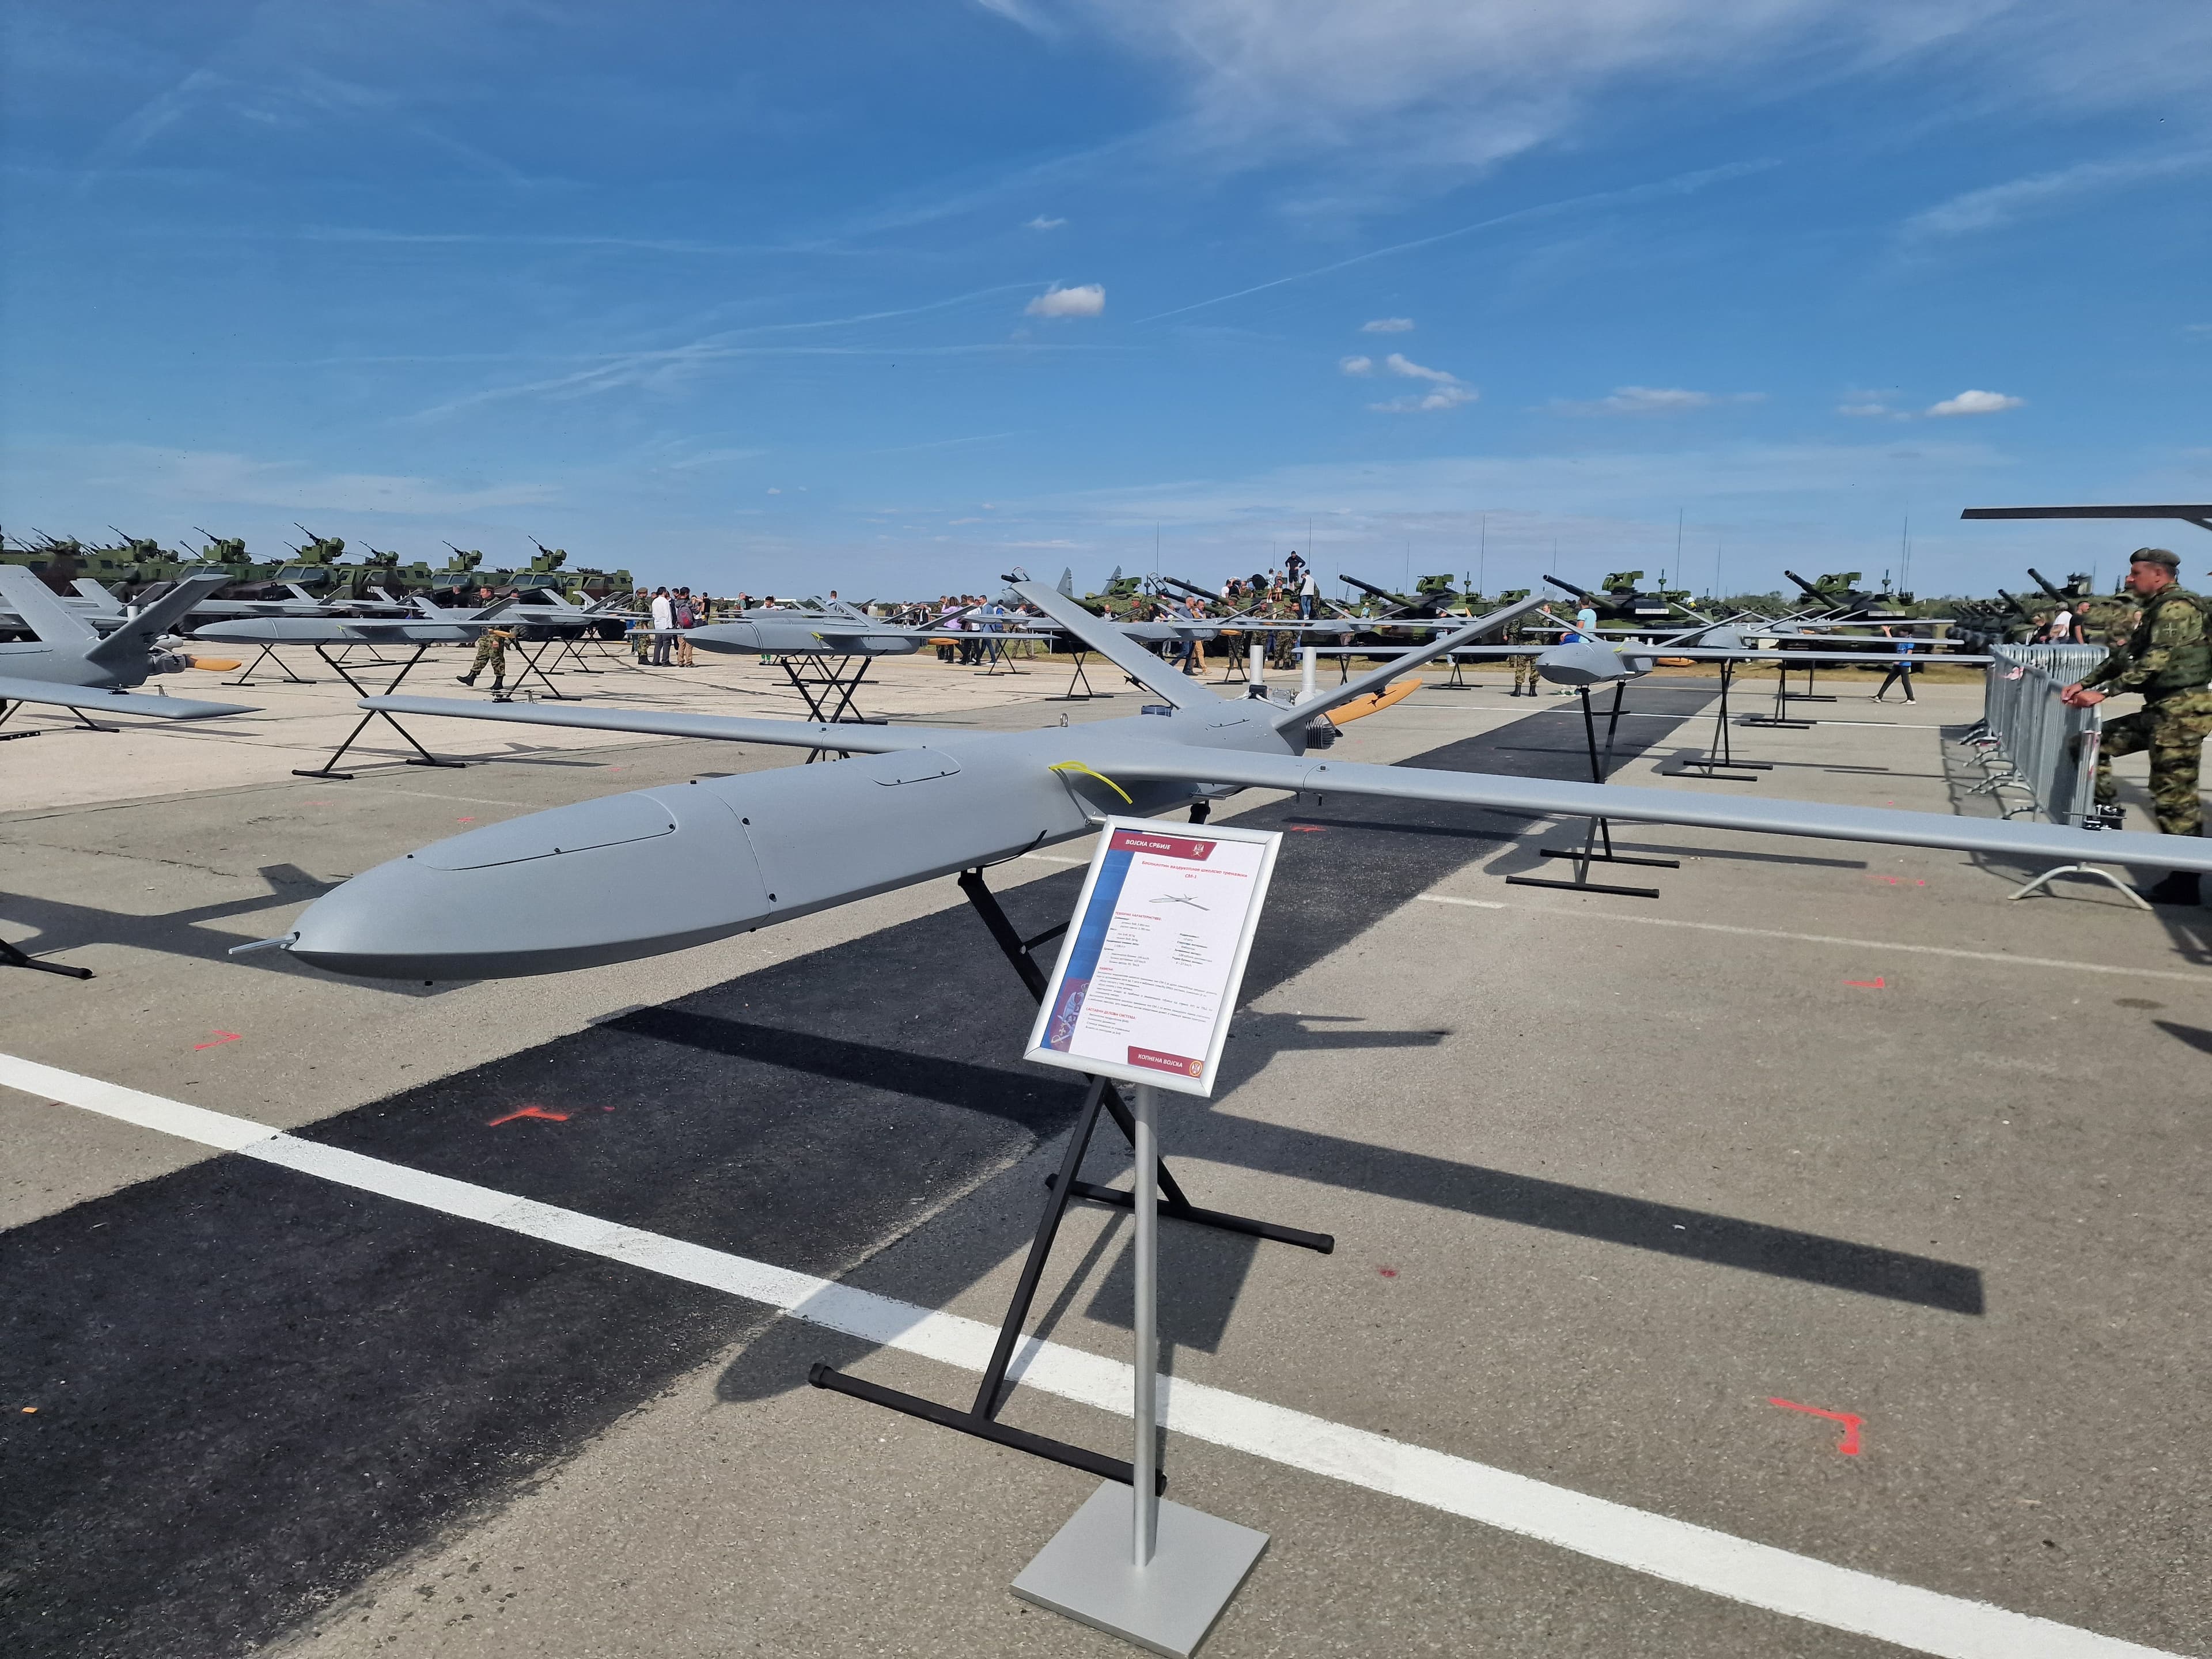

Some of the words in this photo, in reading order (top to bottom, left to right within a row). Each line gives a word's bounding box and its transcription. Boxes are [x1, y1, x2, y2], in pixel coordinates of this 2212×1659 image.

[1149, 842, 1171, 850] СРБИЈЕ
[1138, 1054, 1162, 1063] КОПНЕНА
[1164, 1059, 1183, 1067] ВОЈСКА
